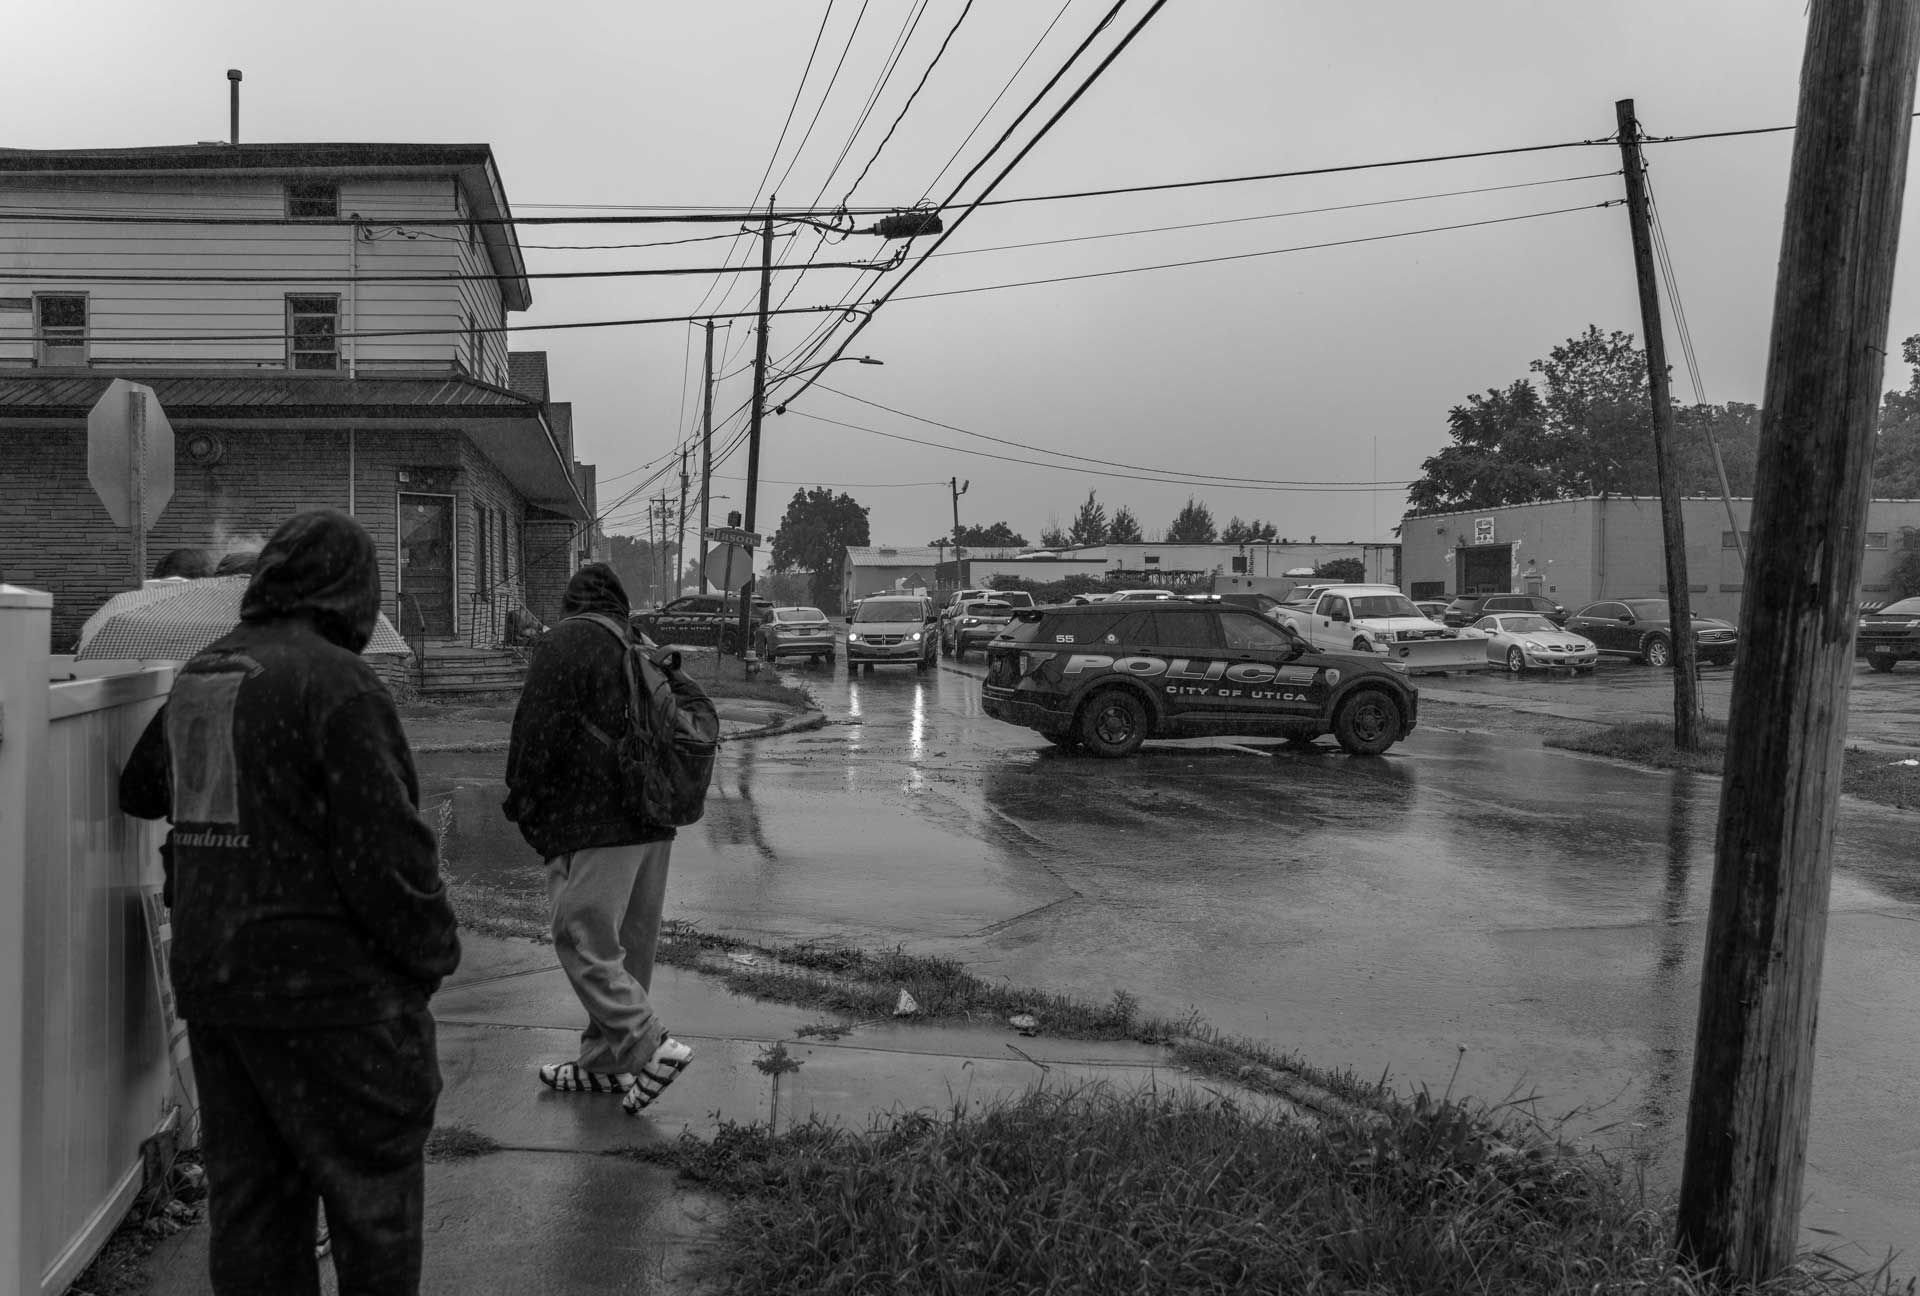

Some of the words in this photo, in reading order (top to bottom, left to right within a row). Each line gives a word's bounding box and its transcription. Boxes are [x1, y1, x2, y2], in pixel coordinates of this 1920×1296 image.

[1056, 634, 1075, 643] 55
[1063, 654, 1320, 686] POLICE
[1166, 685, 1210, 695] CITY
[1218, 689, 1242, 697] OF
[1251, 690, 1307, 701] UTICA
